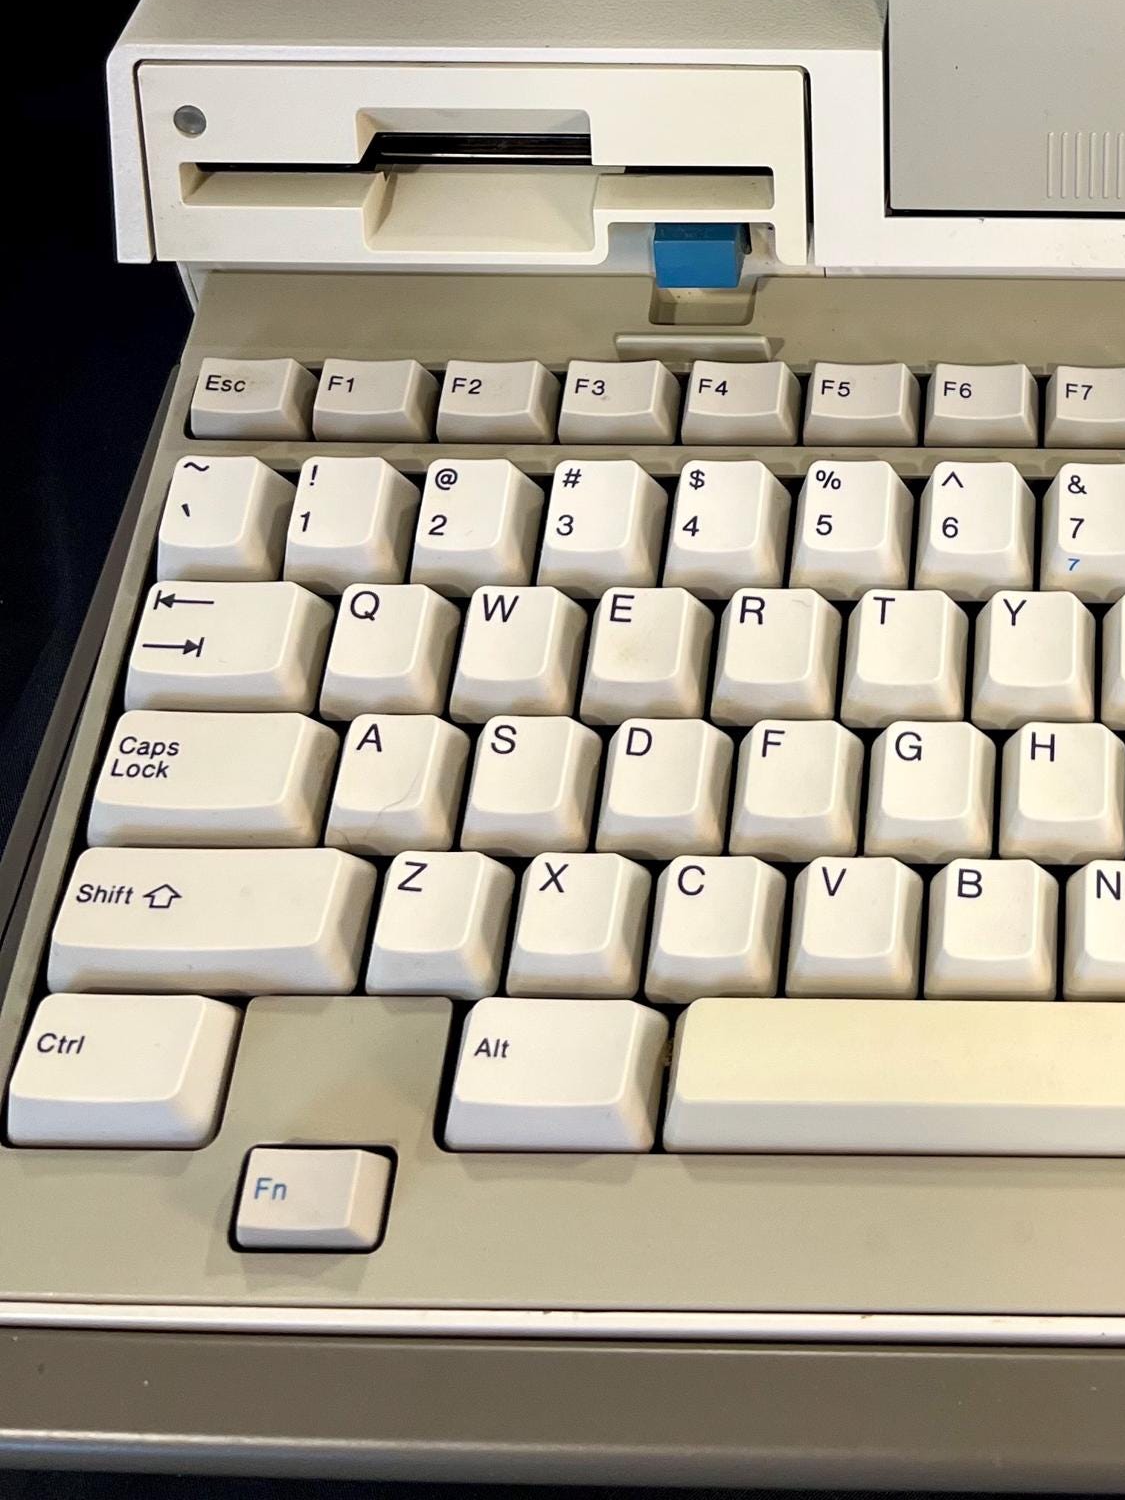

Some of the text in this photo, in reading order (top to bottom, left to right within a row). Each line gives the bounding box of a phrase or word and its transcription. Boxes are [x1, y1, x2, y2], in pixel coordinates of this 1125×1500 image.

[206, 375, 245, 392] Esc
[328, 376, 354, 392] F1
[452, 378, 481, 394] F2
[575, 379, 605, 395] F3
[699, 379, 728, 396] F4
[822, 380, 850, 397] F5
[944, 381, 971, 398] F6
[1066, 383, 1092, 400] F7
[309, 465, 319, 486] !
[435, 469, 457, 490] @
[563, 468, 581, 488] #
[690, 470, 704, 490] $
[816, 470, 841, 489] %
[1068, 475, 1087, 494] &
[301, 512, 310, 532] 1
[429, 515, 447, 535] 2
[557, 515, 573, 536] 3
[683, 516, 699, 536] 4
[816, 515, 832, 535] 5
[943, 517, 958, 538] 6
[1070, 518, 1084, 538] 7
[1069, 559, 1080, 571] 7
[350, 591, 379, 621] Q
[483, 594, 519, 622] W
[610, 594, 634, 622] E
[740, 596, 765, 624] R
[874, 597, 895, 624] T
[1004, 599, 1026, 626] Y
[120, 737, 179, 759] Caps
[356, 724, 382, 752] A
[491, 725, 516, 754] S
[626, 727, 652, 756] D
[762, 730, 785, 757] F
[895, 732, 921, 761] G
[1031, 732, 1055, 762] H
[111, 759, 168, 778] Lock
[398, 862, 427, 892] Z
[539, 863, 568, 893] X
[678, 866, 705, 895] C
[822, 867, 846, 896] V
[958, 869, 982, 898] B
[1097, 870, 1120, 900] N
[76, 884, 133, 904] Shift
[37, 1033, 84, 1054] Ctrl
[474, 1038, 509, 1058] Alt
[255, 1178, 286, 1200] Fn
